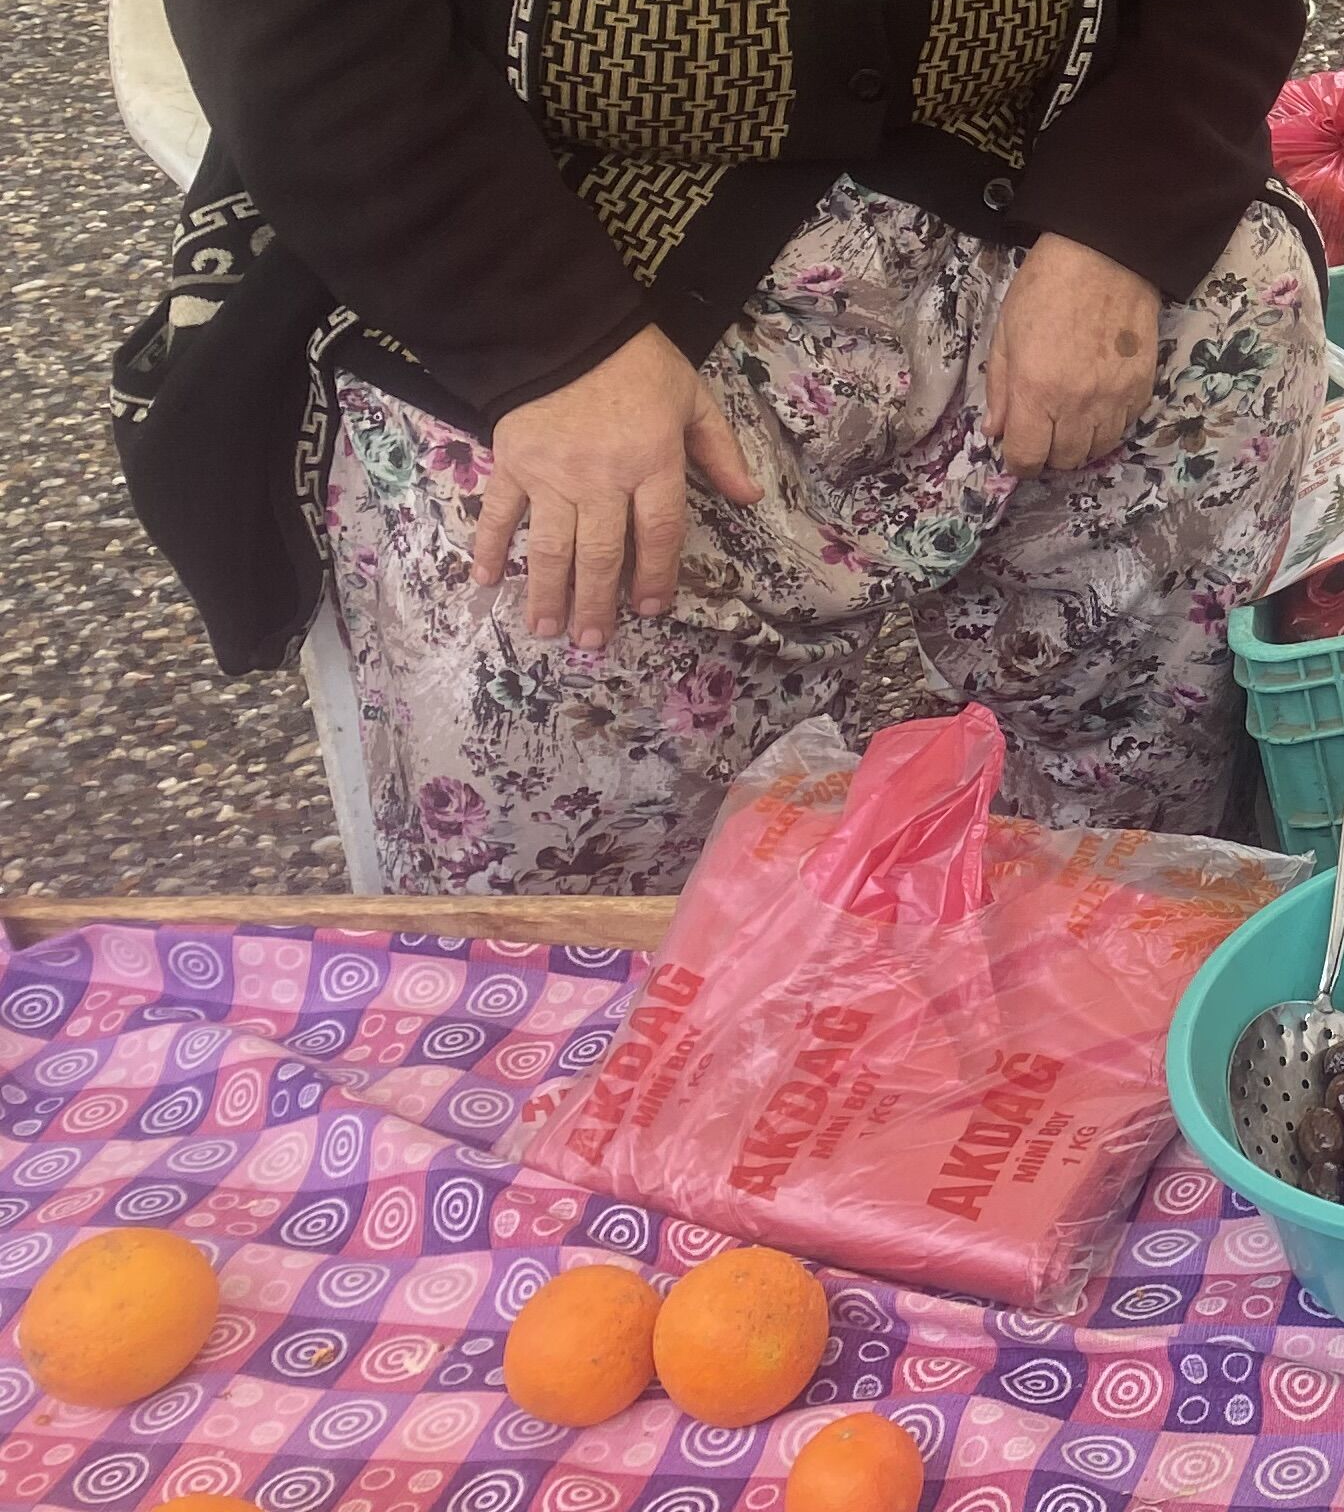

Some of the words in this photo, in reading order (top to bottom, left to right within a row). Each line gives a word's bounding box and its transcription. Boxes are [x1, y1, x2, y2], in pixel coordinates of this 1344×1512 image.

[666, 1024, 702, 1071] BOY
[727, 1000, 875, 1201] AKDAĞ
[808, 1114, 850, 1160] MİNİ
[843, 1063, 881, 1117] BOY
[868, 1093, 900, 1125] KG
[926, 1048, 1065, 1222] AKDAĞ
[1011, 1138, 1051, 1184] MİNİ
[1038, 1110, 1075, 1143] BOY
[1068, 1124, 1099, 1157] KG
